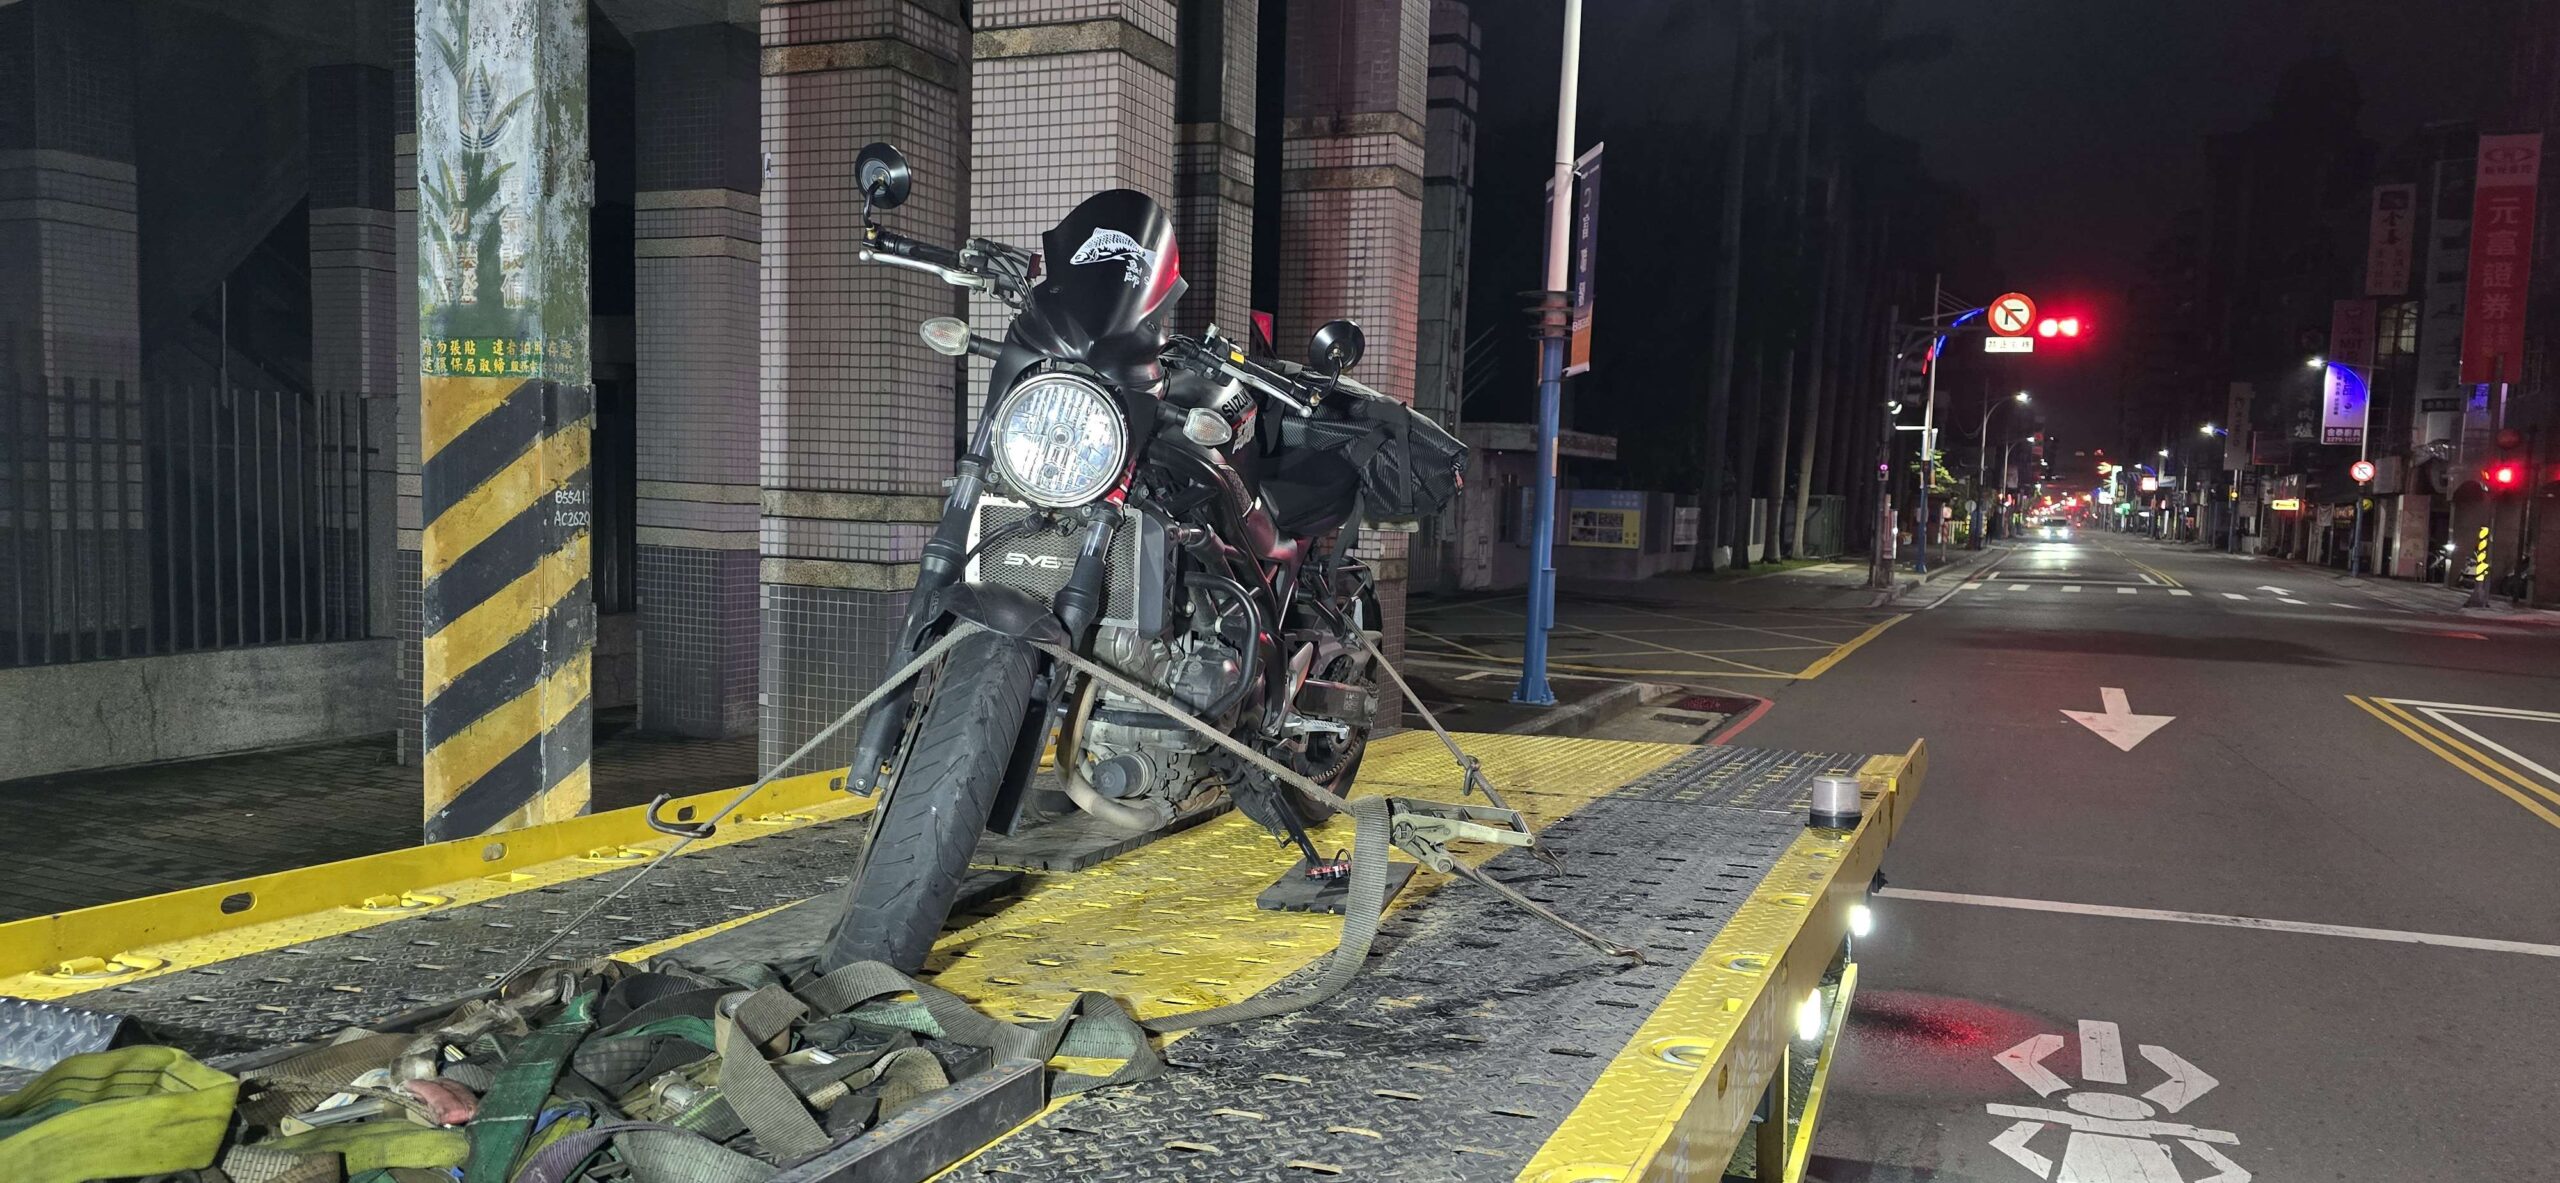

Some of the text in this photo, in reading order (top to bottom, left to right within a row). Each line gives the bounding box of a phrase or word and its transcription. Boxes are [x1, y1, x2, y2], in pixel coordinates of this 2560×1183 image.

[2480, 197, 2521, 320] 元富證券
[422, 338, 476, 356] 請勿張貼
[1222, 388, 1252, 420] SUZUK
[555, 490, 585, 504] B5541
